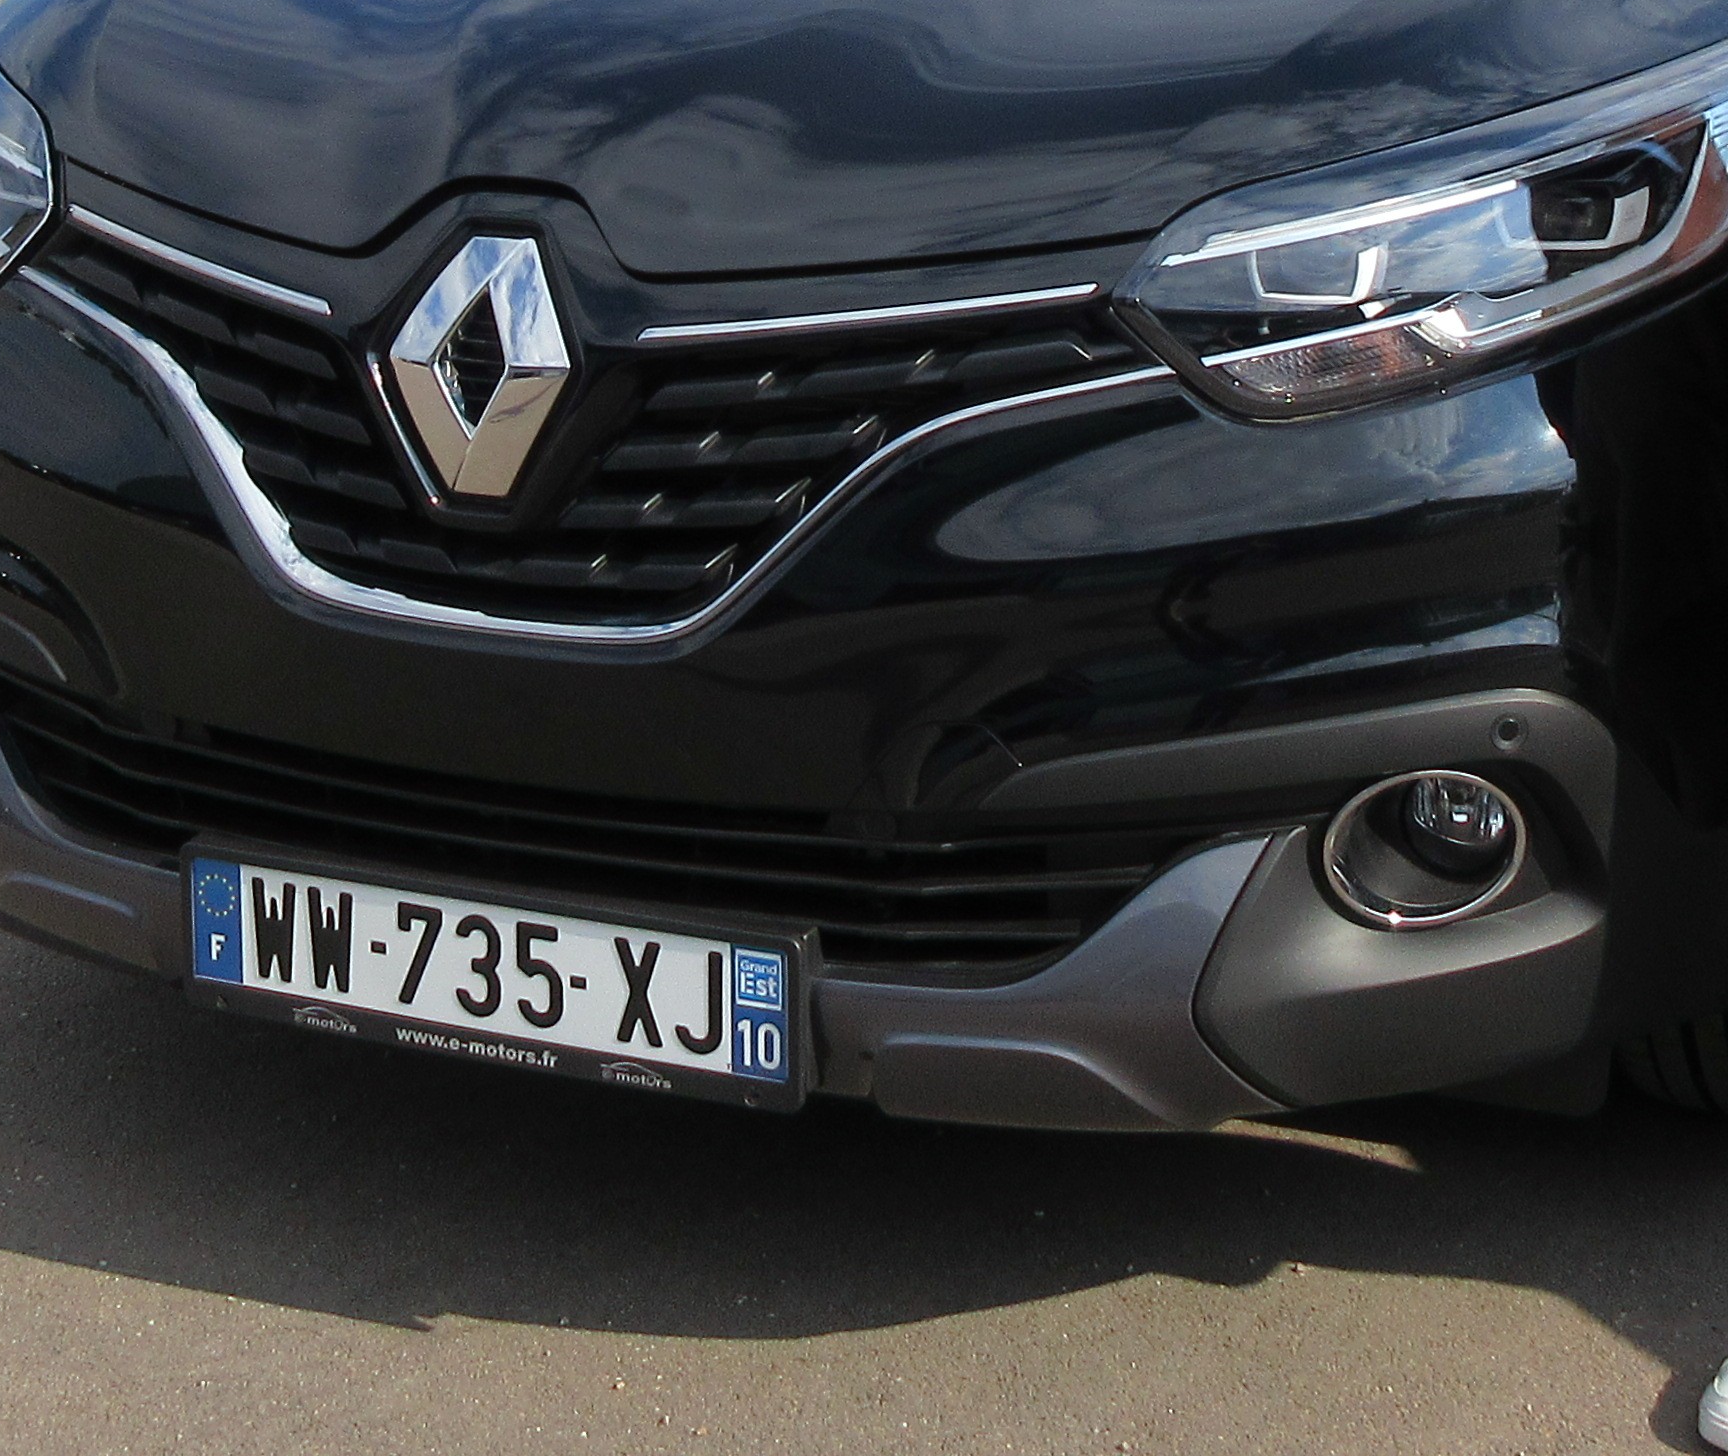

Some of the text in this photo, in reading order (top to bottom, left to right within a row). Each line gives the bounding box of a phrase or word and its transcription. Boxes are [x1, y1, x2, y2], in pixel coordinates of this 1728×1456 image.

[210, 933, 226, 961] F
[251, 876, 723, 1055] WW-735-XJ
[740, 959, 778, 975] Grand
[740, 971, 778, 998] Est
[395, 1026, 559, 1068] www.e-motors.fr
[737, 1018, 782, 1071] 10
